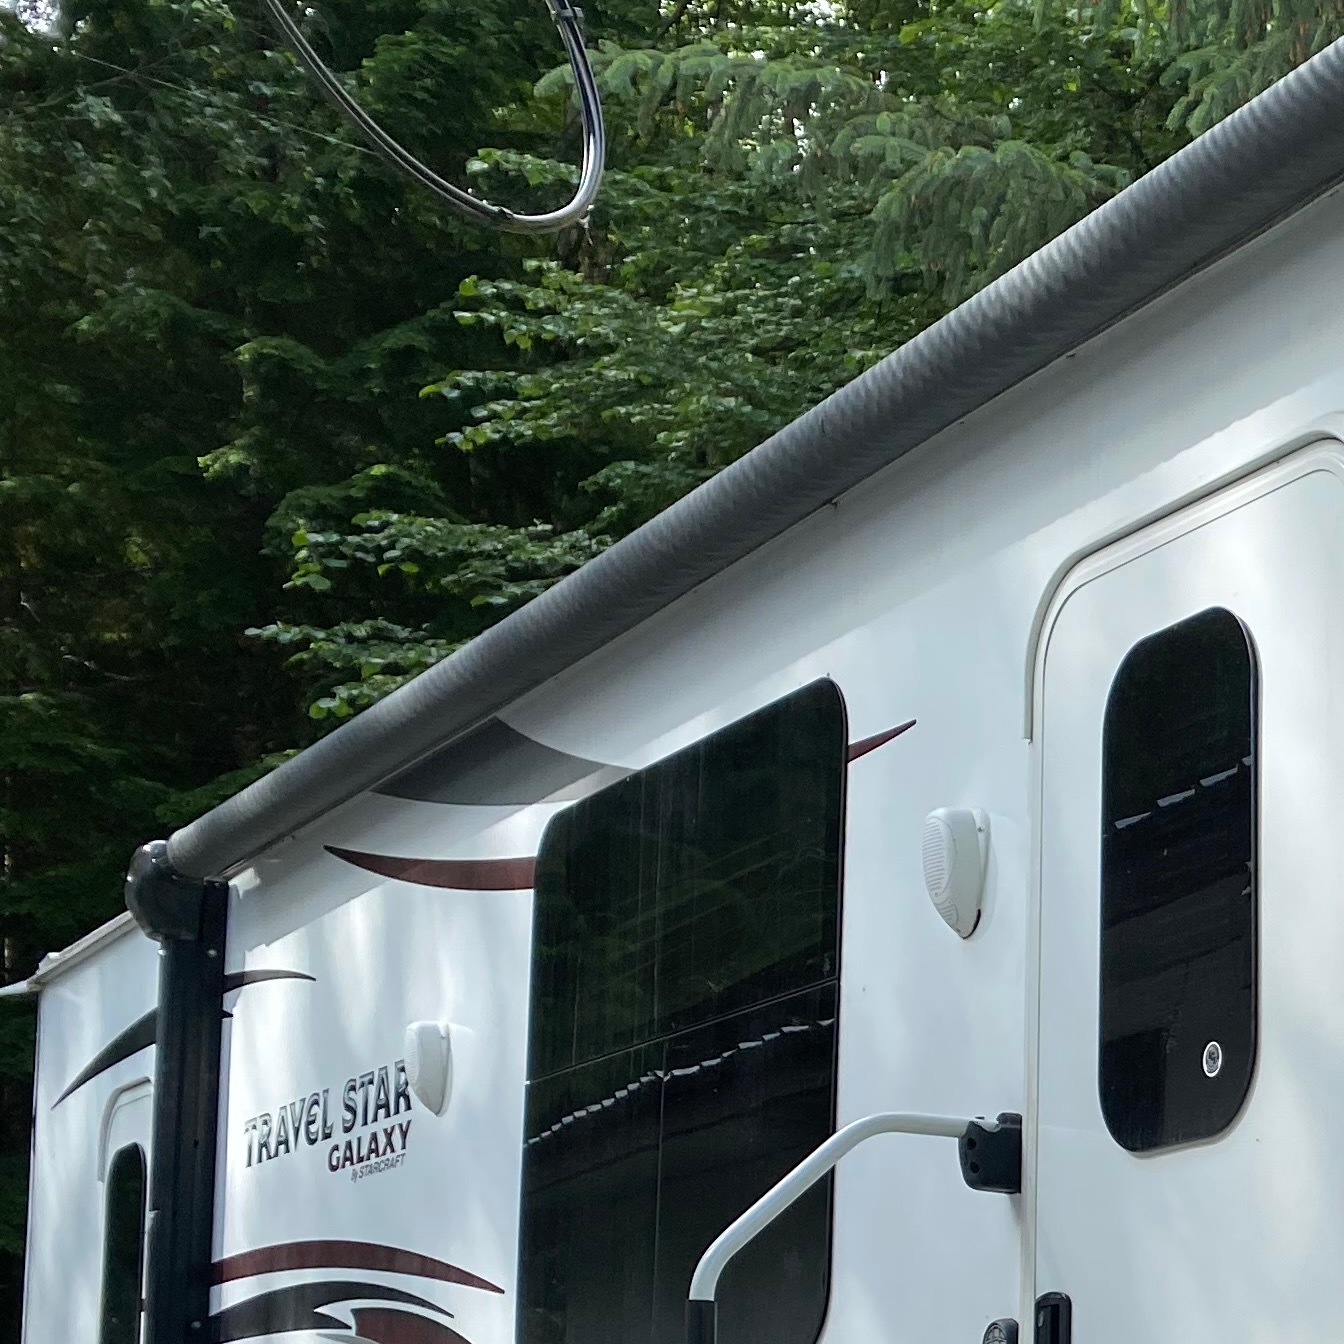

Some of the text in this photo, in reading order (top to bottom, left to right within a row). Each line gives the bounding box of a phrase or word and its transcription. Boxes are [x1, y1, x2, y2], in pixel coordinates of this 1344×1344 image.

[244, 1059, 413, 1168] TRAVEL STAR
[328, 1119, 412, 1173] GALAXY
[359, 1153, 406, 1179] STARCRAFT
